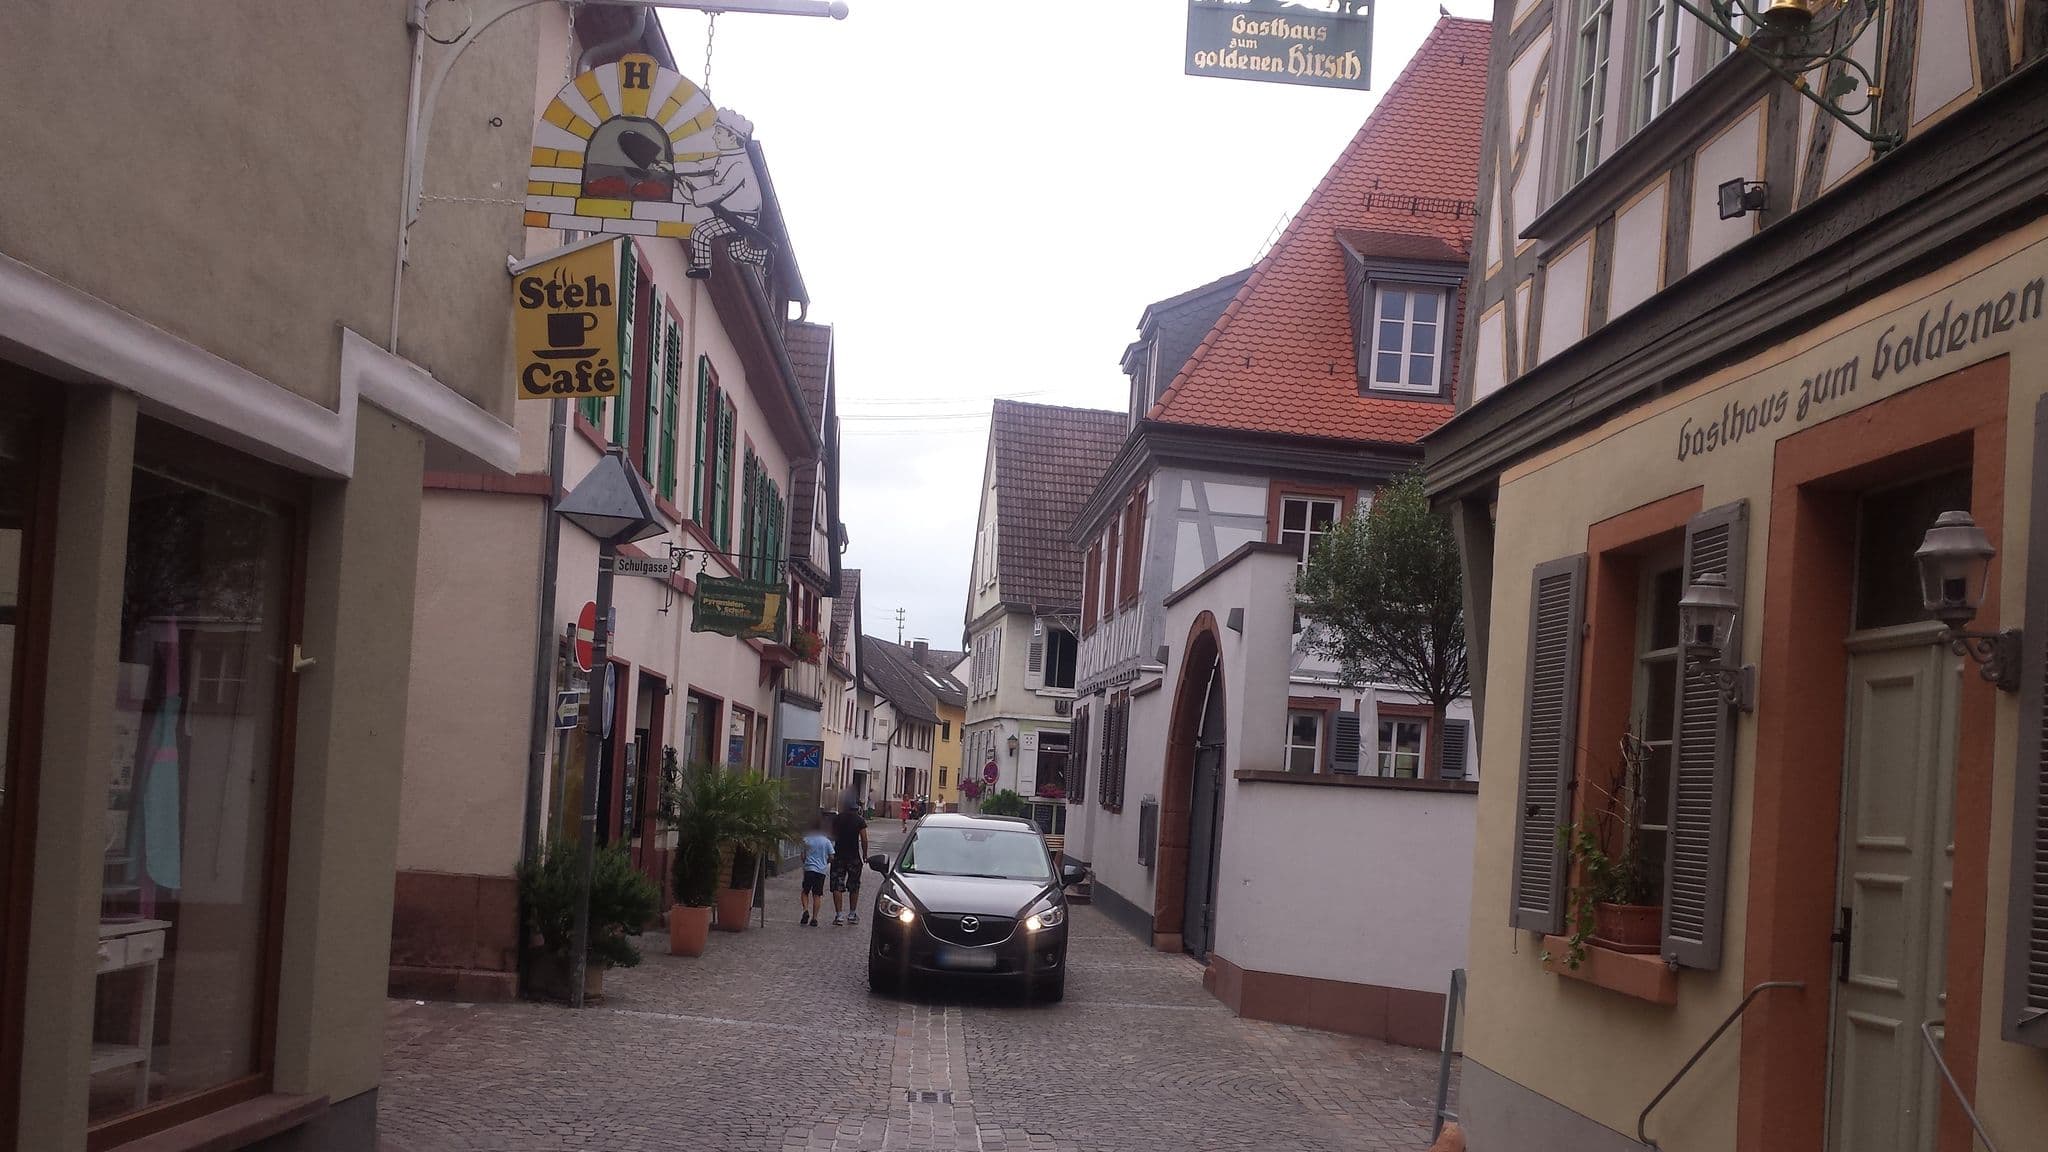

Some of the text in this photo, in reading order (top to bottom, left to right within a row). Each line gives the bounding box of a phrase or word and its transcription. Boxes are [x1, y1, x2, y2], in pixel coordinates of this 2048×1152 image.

[1229, 38, 1258, 49] zum
[1231, 14, 1328, 42] Gasthaus
[622, 61, 651, 89] H
[1194, 43, 1362, 81] goldenen Hirsch
[518, 275, 612, 310] Steh
[522, 359, 615, 395] Café
[1677, 275, 2045, 462] Gasthaus zum Goldenen
[618, 559, 668, 575] Schulgasse
